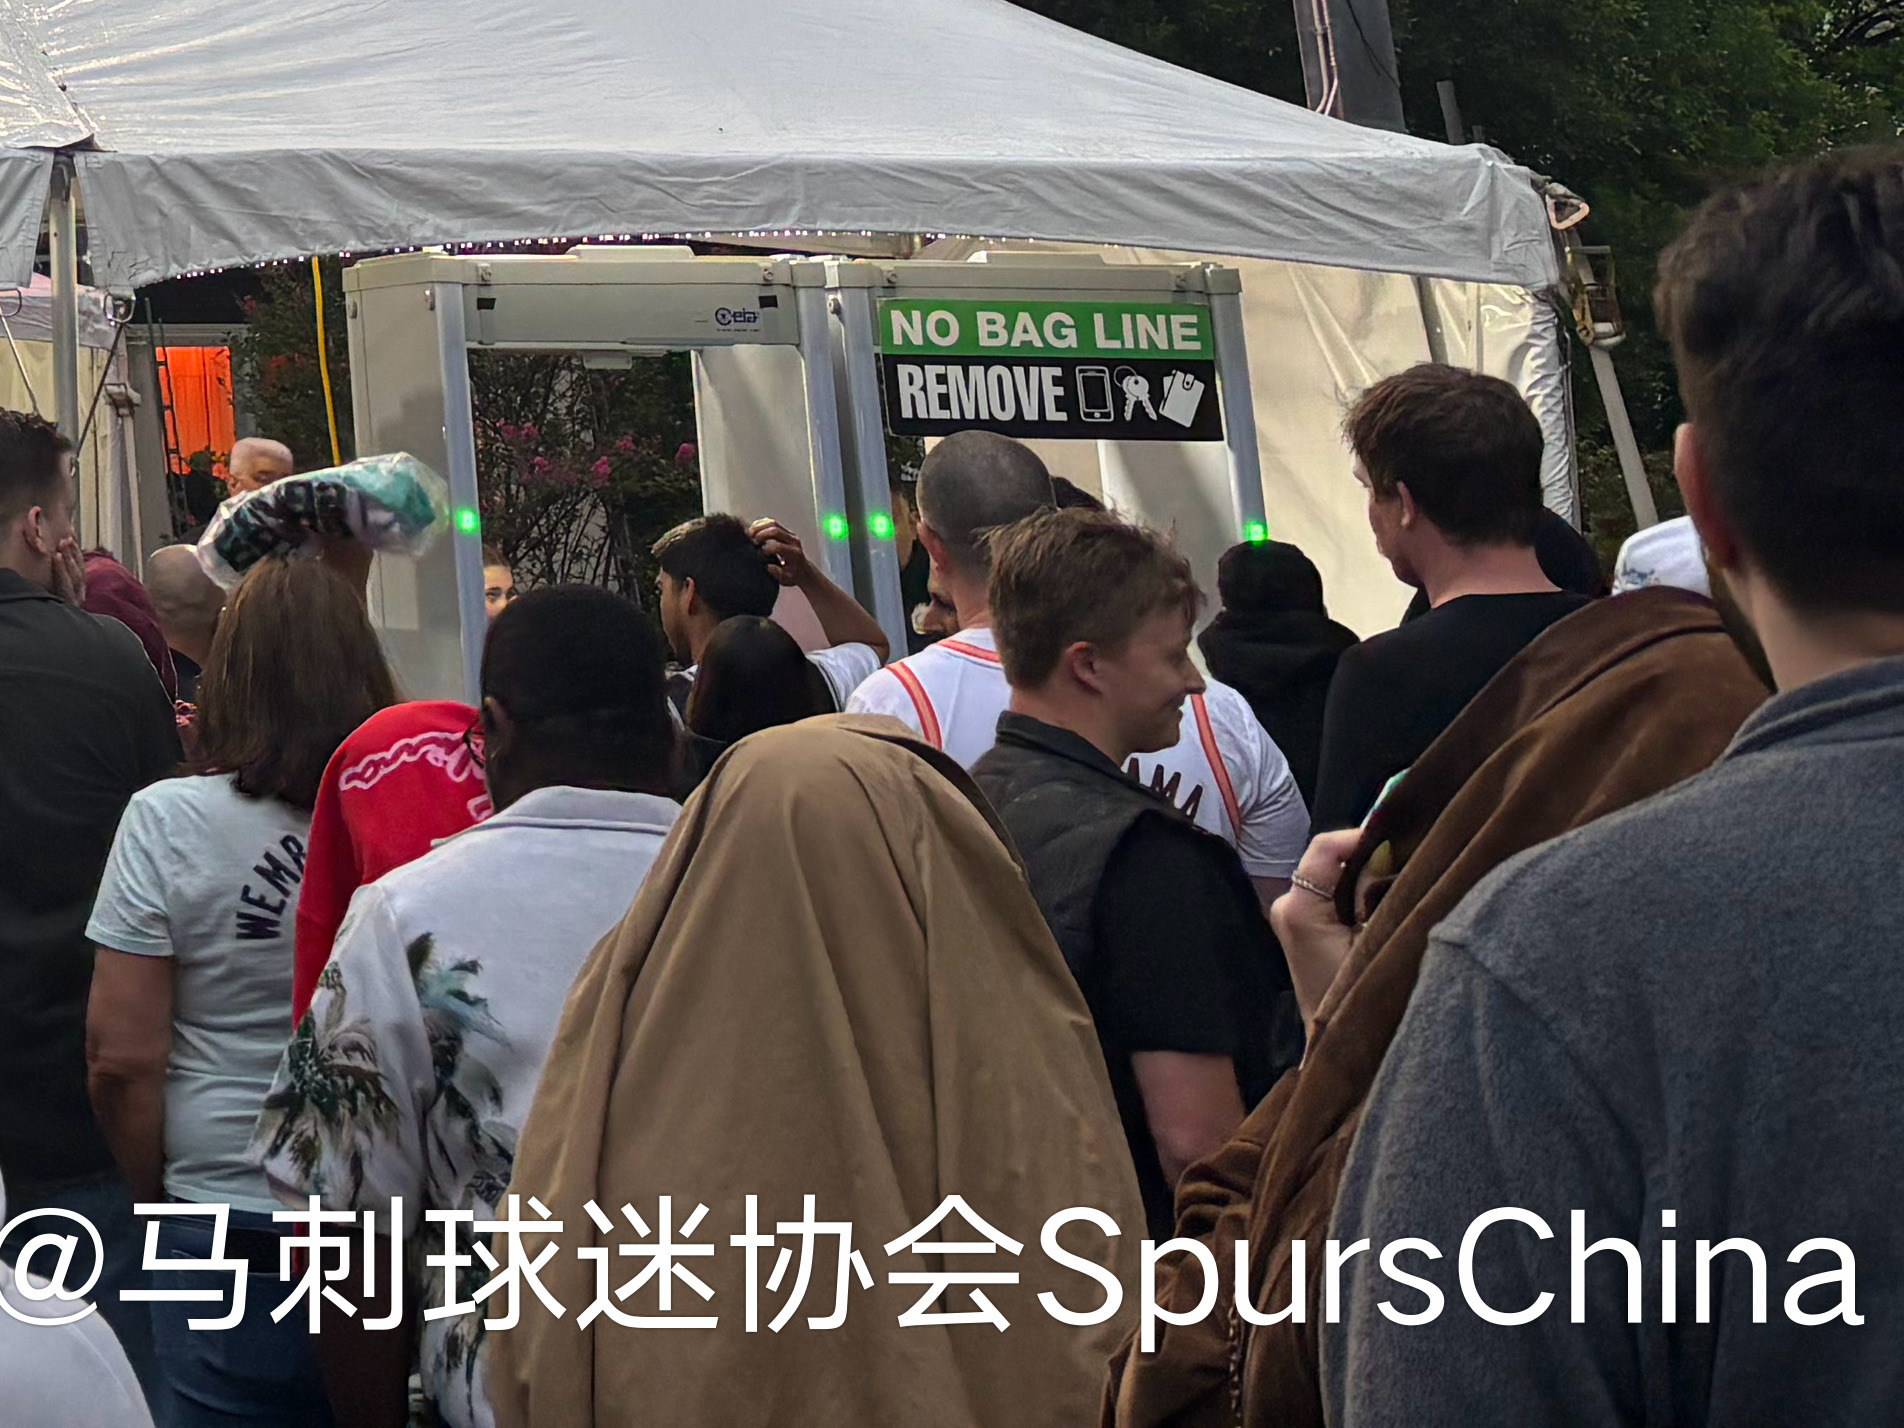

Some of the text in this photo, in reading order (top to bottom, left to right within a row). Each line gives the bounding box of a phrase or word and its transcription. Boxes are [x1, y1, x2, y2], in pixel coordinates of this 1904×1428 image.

[891, 309, 1202, 352] NO BAG LINE
[897, 363, 1068, 422] REMOVE
[235, 834, 307, 940] WEMB
